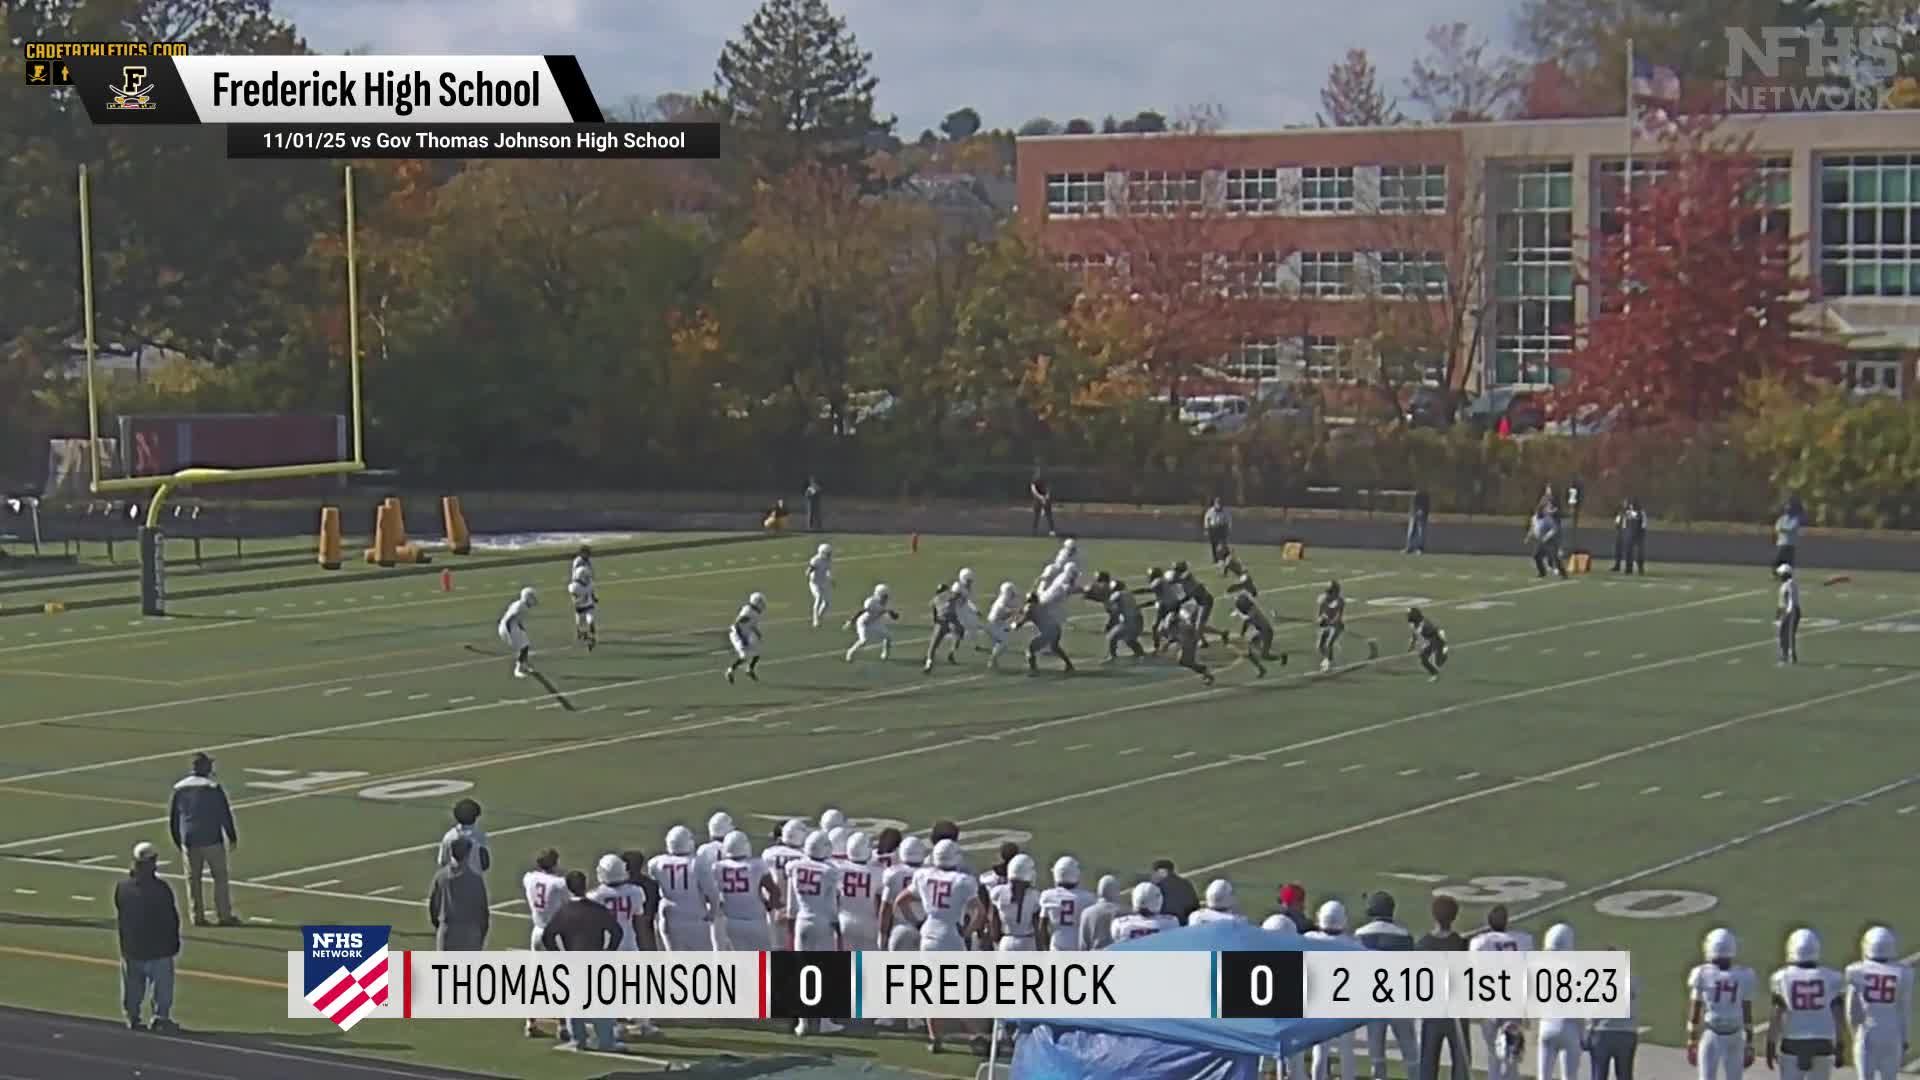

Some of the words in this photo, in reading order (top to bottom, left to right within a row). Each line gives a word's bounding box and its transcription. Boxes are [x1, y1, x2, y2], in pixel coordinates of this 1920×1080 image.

[662, 863, 690, 891] 77
[722, 867, 750, 894] 55
[796, 867, 823, 897] 25
[843, 871, 872, 899] 64
[534, 881, 548, 912] 3
[926, 879, 953, 909] 72
[1060, 899, 1076, 926] 2
[1713, 979, 1739, 1004] 14
[1791, 979, 1826, 1011] 62
[1864, 973, 1897, 1004] 26
